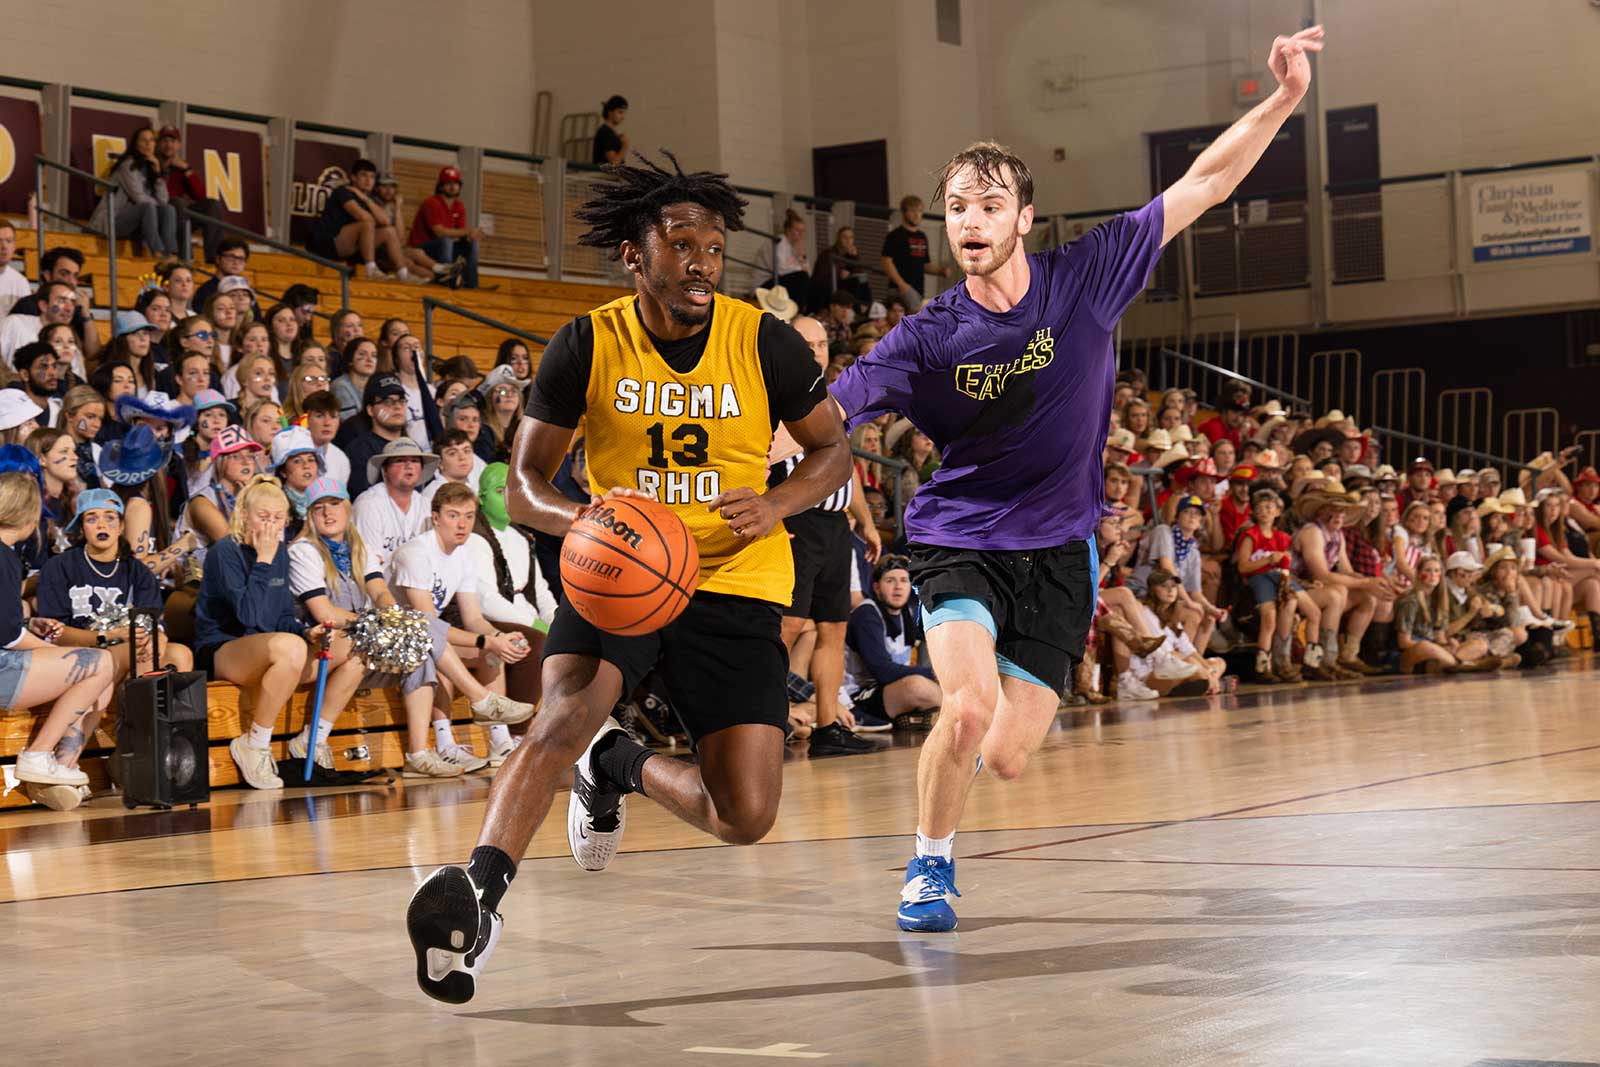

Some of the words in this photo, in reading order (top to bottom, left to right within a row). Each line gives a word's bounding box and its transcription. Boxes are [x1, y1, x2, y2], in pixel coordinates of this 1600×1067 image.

[290, 182, 332, 217] LIO
[1030, 326, 1052, 344] HI
[614, 376, 742, 420] SIGMA
[646, 421, 709, 468] 13
[103, 468, 157, 485] DORM
[636, 467, 721, 505] RHO
